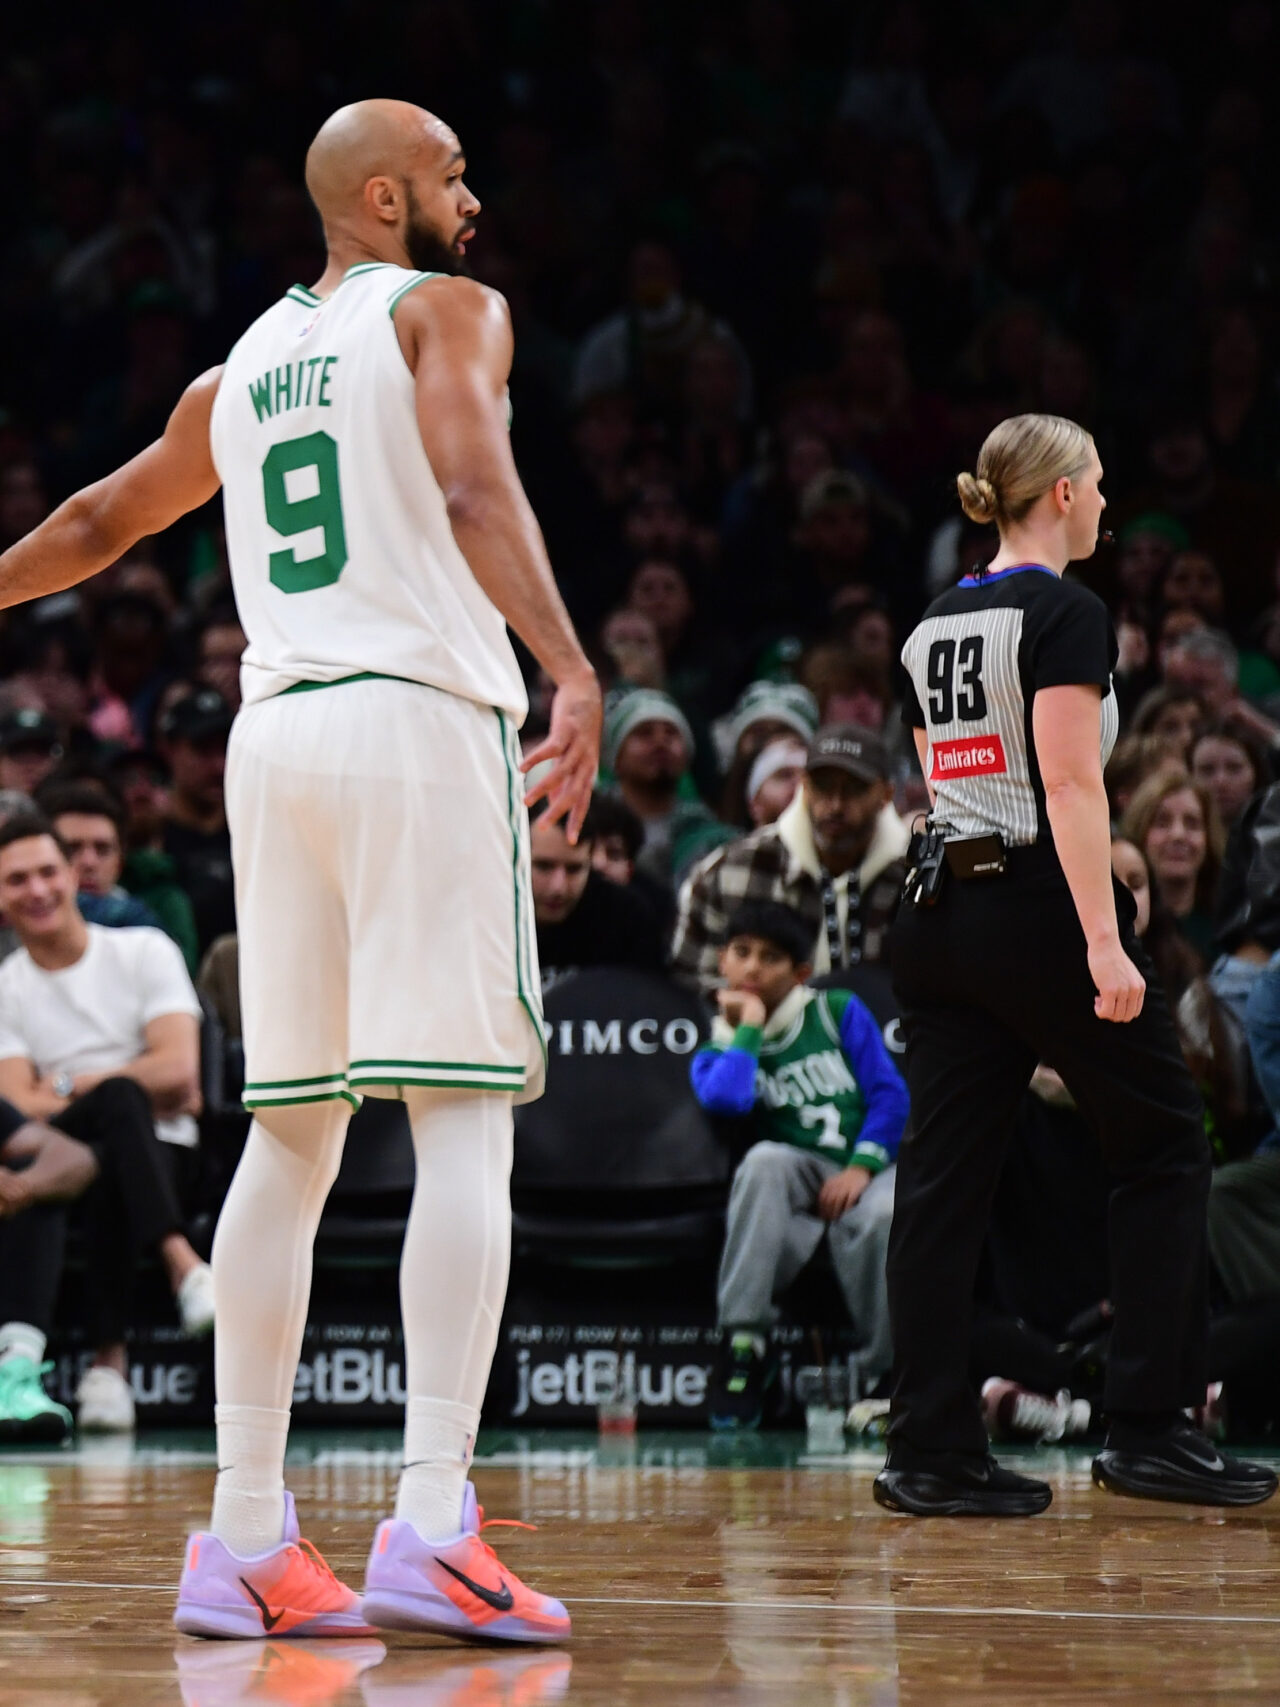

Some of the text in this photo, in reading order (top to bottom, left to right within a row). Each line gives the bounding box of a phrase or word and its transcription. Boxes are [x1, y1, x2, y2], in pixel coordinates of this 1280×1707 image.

[249, 356, 339, 424] WHITE
[262, 430, 349, 594] 9
[927, 635, 988, 725] 93
[936, 745, 996, 772] Emirates
[800, 1101, 847, 1150] 7
[511, 1348, 708, 1418] jetBlue
